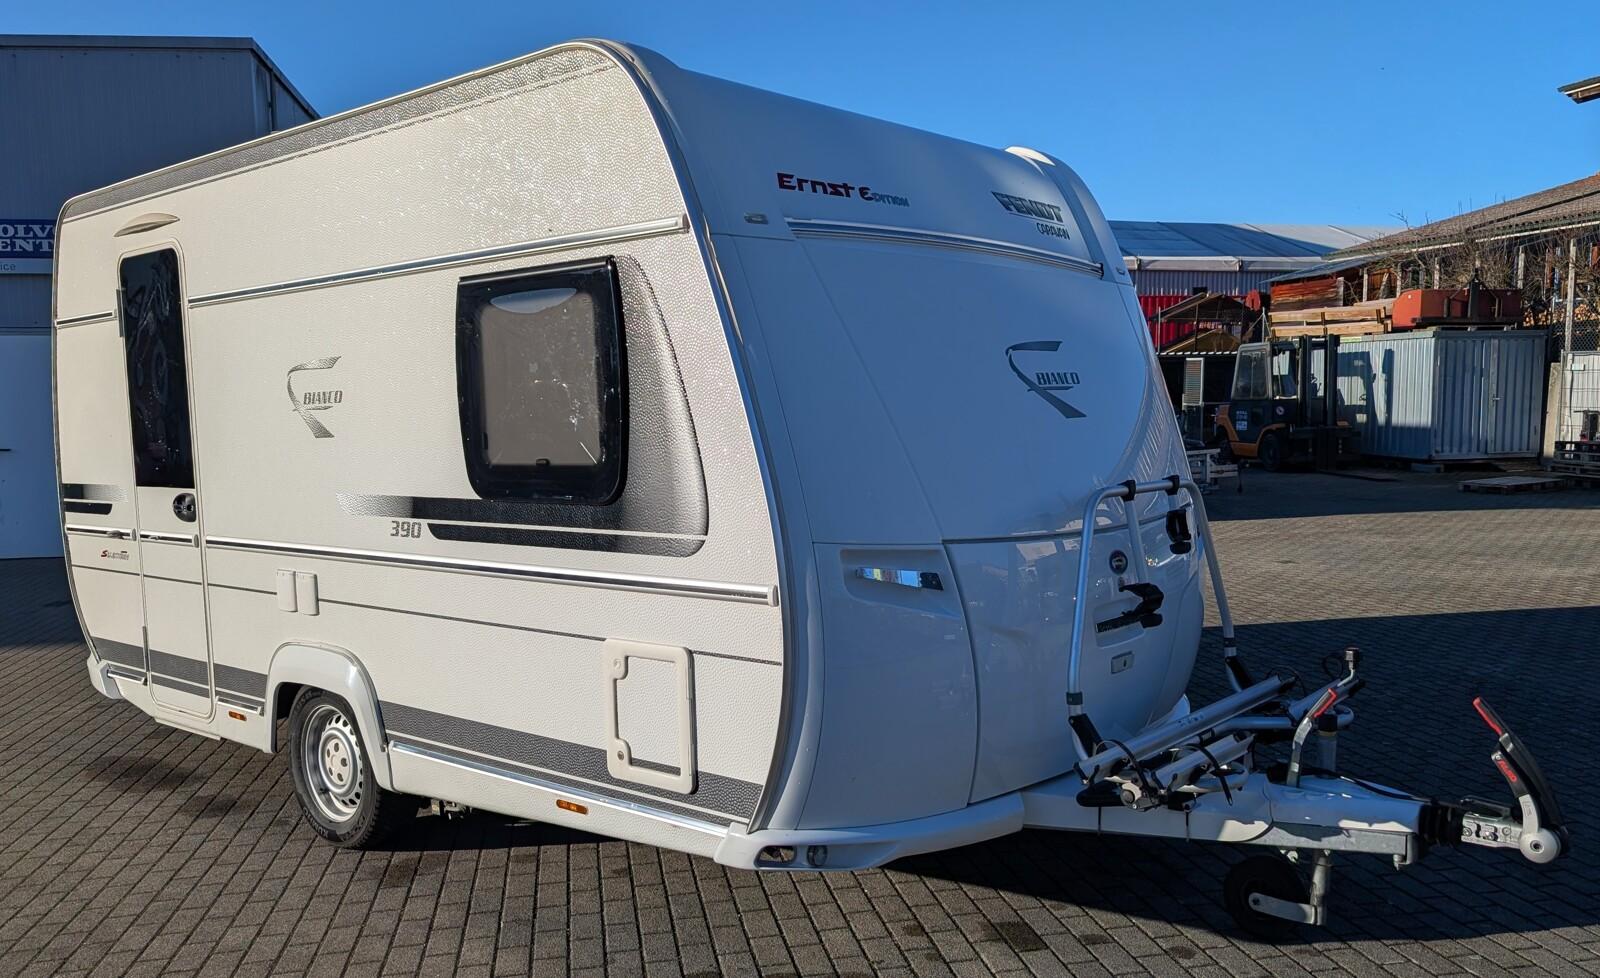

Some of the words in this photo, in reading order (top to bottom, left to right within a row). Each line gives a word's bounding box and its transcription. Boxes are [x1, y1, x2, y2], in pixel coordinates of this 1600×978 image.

[991, 191, 1064, 223] FENDT
[0, 224, 55, 238] OLV
[1035, 371, 1081, 386] BIANCO
[303, 390, 343, 405] BIANCO
[390, 520, 422, 539] 390
